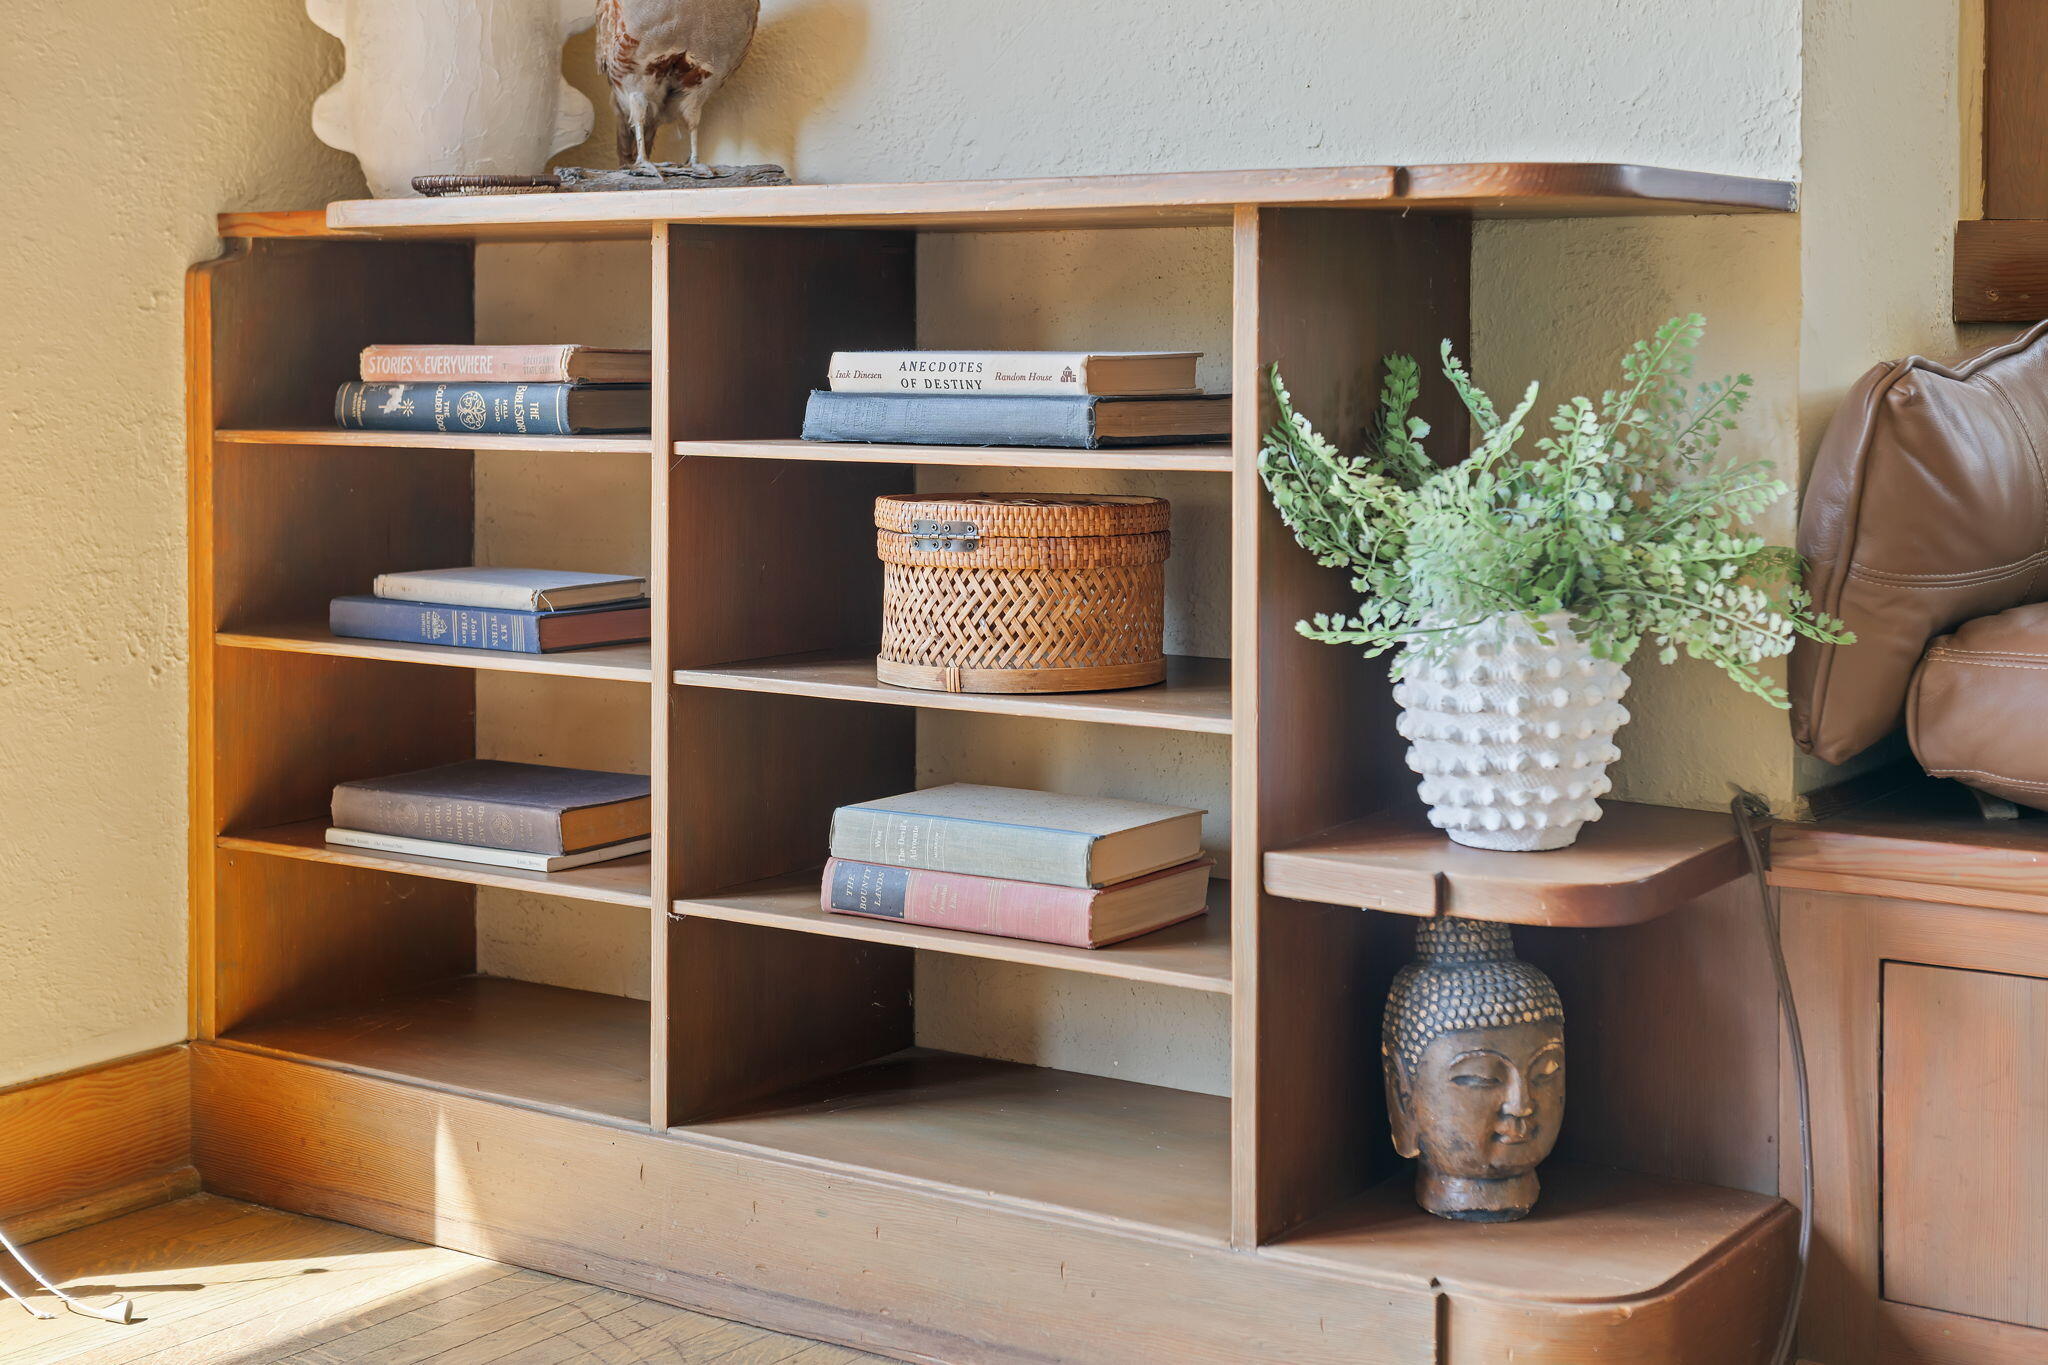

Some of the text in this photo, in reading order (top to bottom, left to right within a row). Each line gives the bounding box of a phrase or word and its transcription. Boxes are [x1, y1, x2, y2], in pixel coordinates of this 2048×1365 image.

[368, 355, 413, 375] STORIES
[424, 354, 493, 375] EVERYWHERE
[853, 370, 882, 379] Dinesen
[899, 361, 983, 373] ANECDOTES
[900, 377, 982, 390] OF DESTINY
[995, 371, 1053, 382] Random House
[434, 384, 447, 413] GOLDEN
[529, 401, 540, 421] THE
[470, 618, 478, 641] John
[490, 615, 499, 647] TURN
[500, 624, 508, 642] MY
[874, 830, 882, 848] West
[898, 847, 906, 863] The
[846, 873, 856, 897] THE
[859, 866, 872, 911] BOUNTY
[874, 871, 885, 907] LANDS
